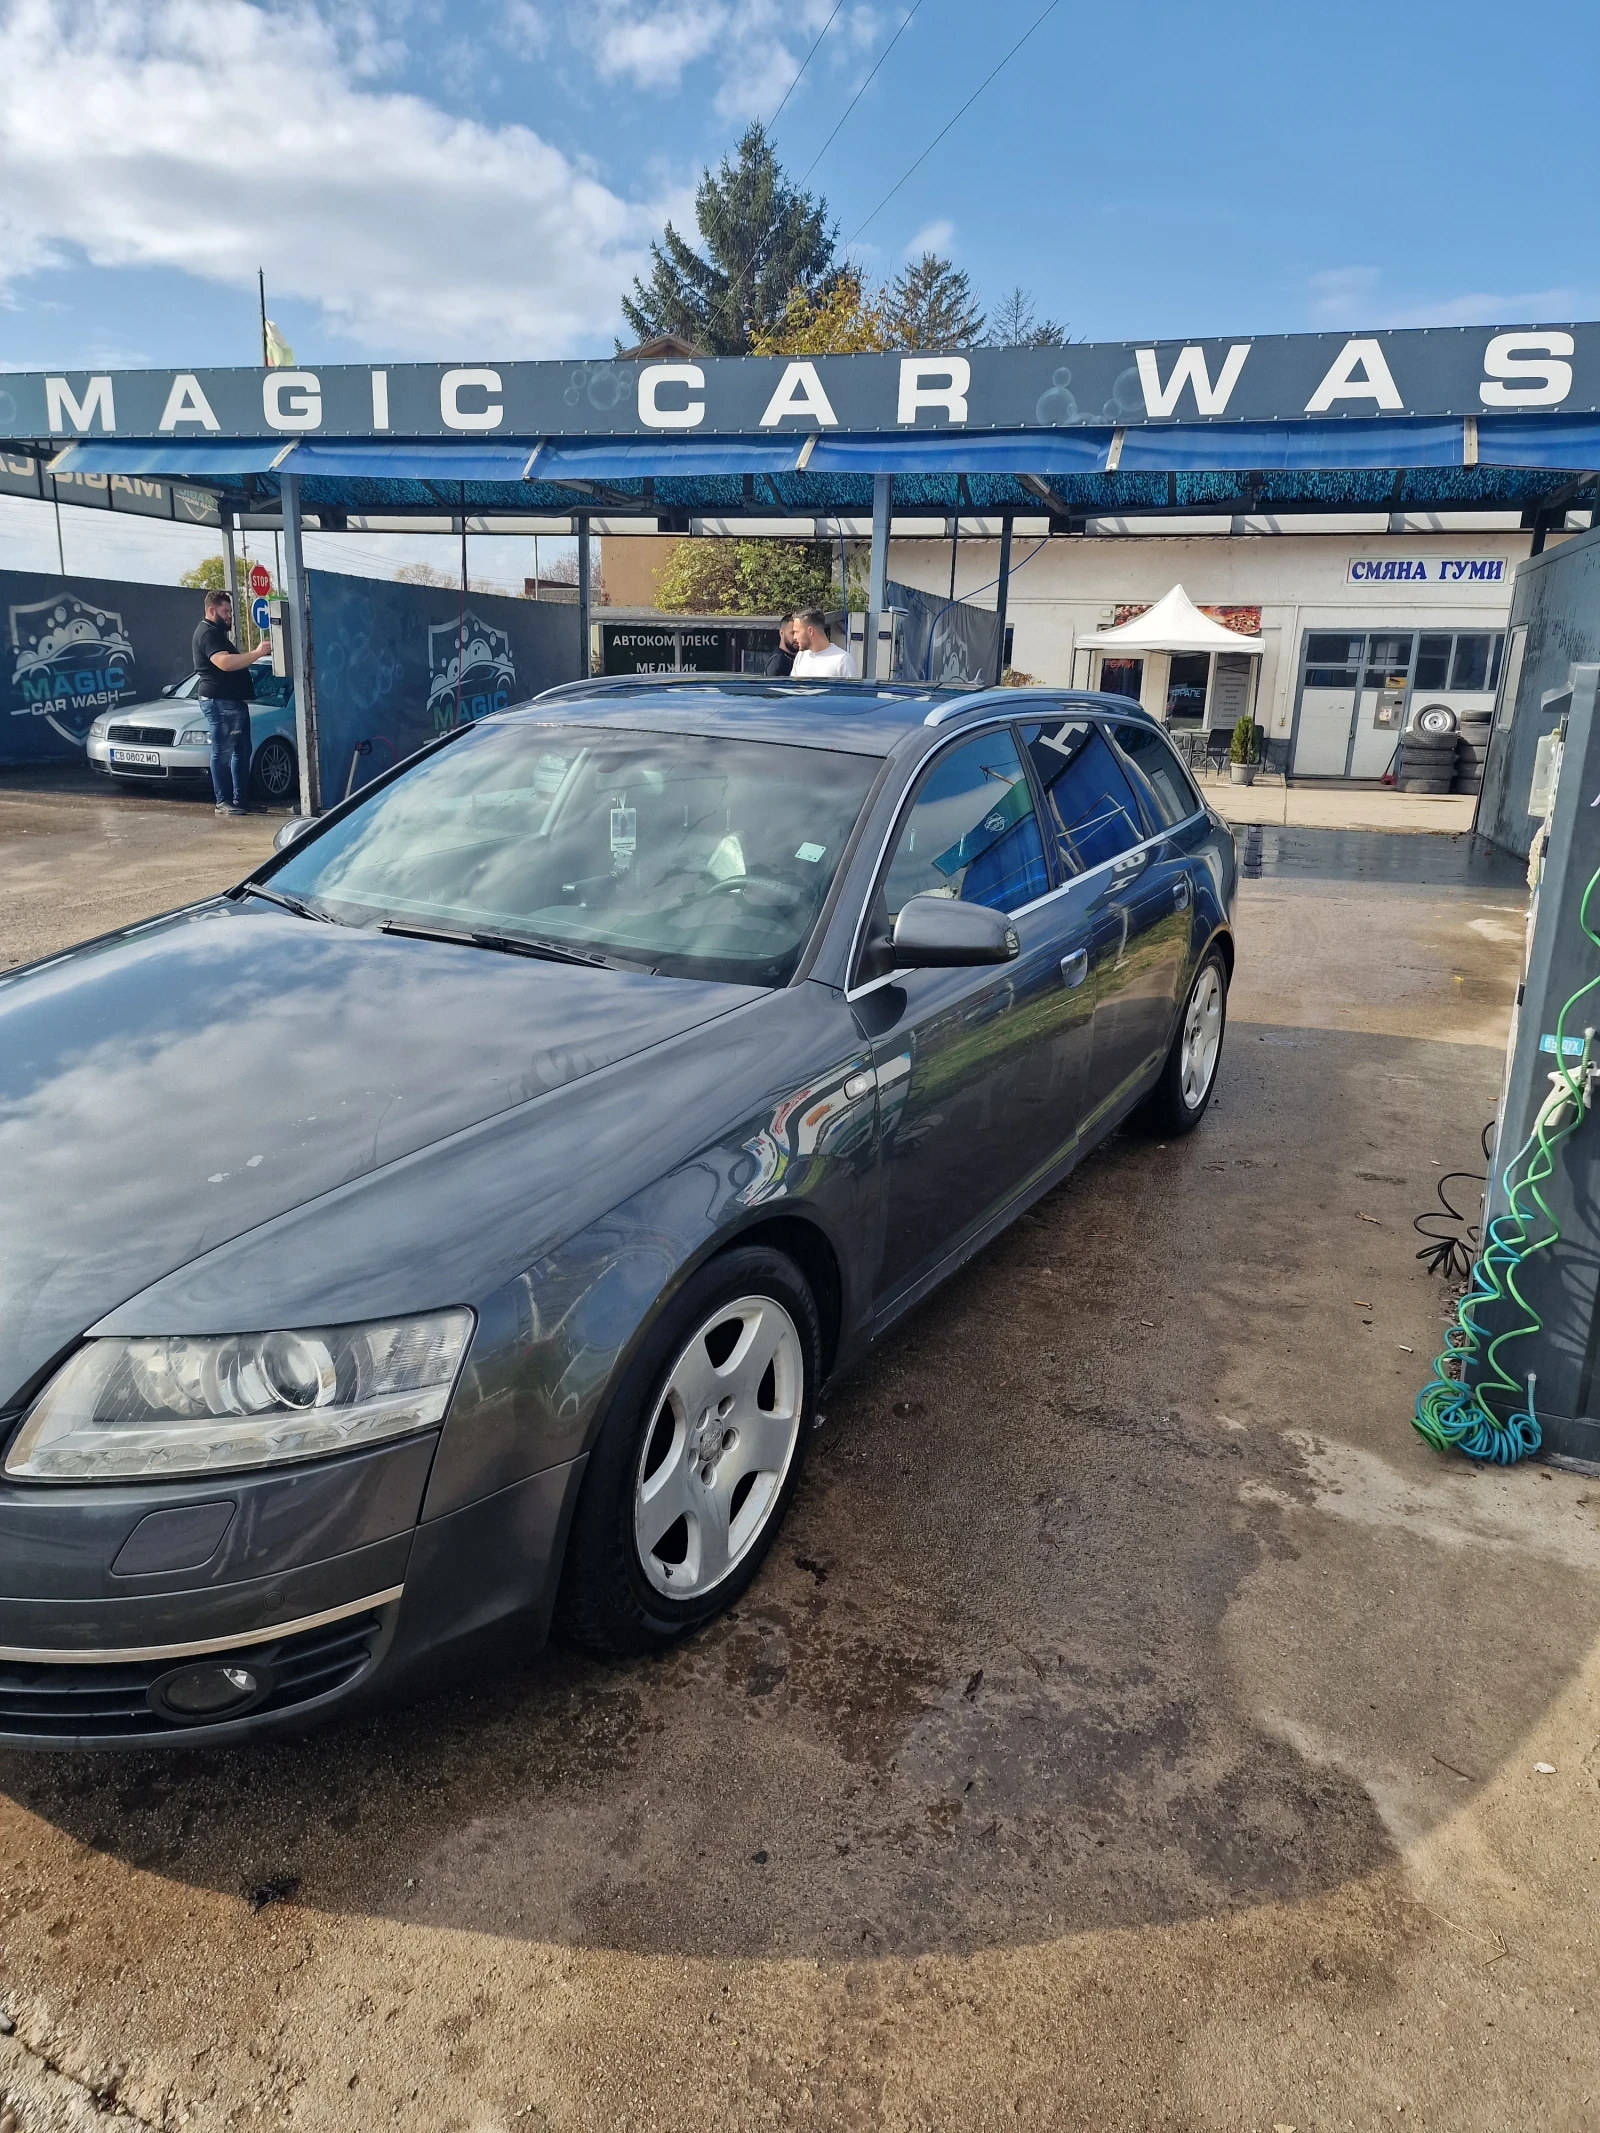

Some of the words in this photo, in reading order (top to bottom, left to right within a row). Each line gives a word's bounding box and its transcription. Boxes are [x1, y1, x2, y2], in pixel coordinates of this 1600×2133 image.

[45, 368, 504, 432] MAGIC
[637, 356, 972, 428] CAR
[1134, 331, 1575, 417] WAS
[252, 575, 269, 588] STOP
[1351, 561, 1428, 580] СМЯНА
[1438, 560, 1504, 580] ГУМИ
[21, 667, 126, 701] MAGIC
[1172, 689, 1201, 698] ФРАПЕ
[31, 698, 67, 716] CAR
[71, 689, 119, 709] WASH
[432, 690, 509, 731] MAGIC
[1545, 1036, 1580, 1053] ВЪДУХ
